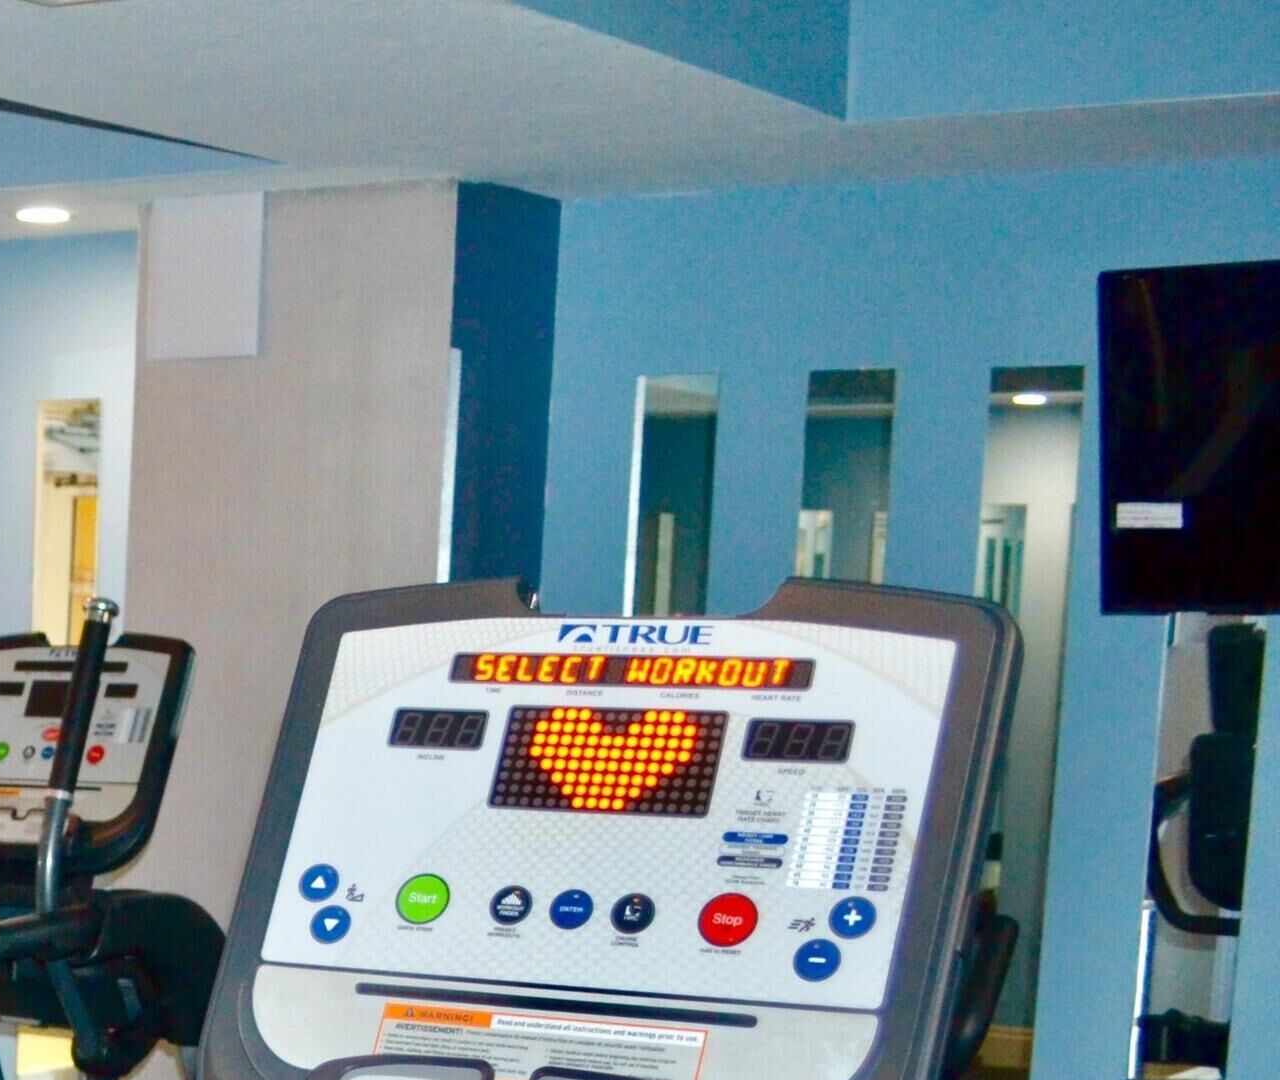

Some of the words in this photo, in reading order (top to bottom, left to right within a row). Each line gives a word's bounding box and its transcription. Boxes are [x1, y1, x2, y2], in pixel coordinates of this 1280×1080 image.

[601, 623, 714, 645] TRUE
[474, 653, 606, 683] SELECT
[626, 655, 790, 688] WORKOUT
[485, 687, 502, 695] TIME
[565, 689, 604, 697] DISTANCE
[659, 692, 700, 700] CALORIES
[750, 694, 778, 702] HEART
[780, 695, 802, 703] RATE
[416, 753, 446, 761] INCLINE
[777, 768, 806, 776] SPEED
[408, 891, 438, 905] Start
[559, 905, 584, 913] ENTER
[711, 912, 744, 928] Stop
[419, 1009, 474, 1023] WARNING!
[496, 1018, 513, 1027] Read
[526, 1021, 562, 1031] understand
[572, 1025, 612, 1036] instructions
[613, 1029, 625, 1037] and
[627, 1031, 656, 1040] warnings
